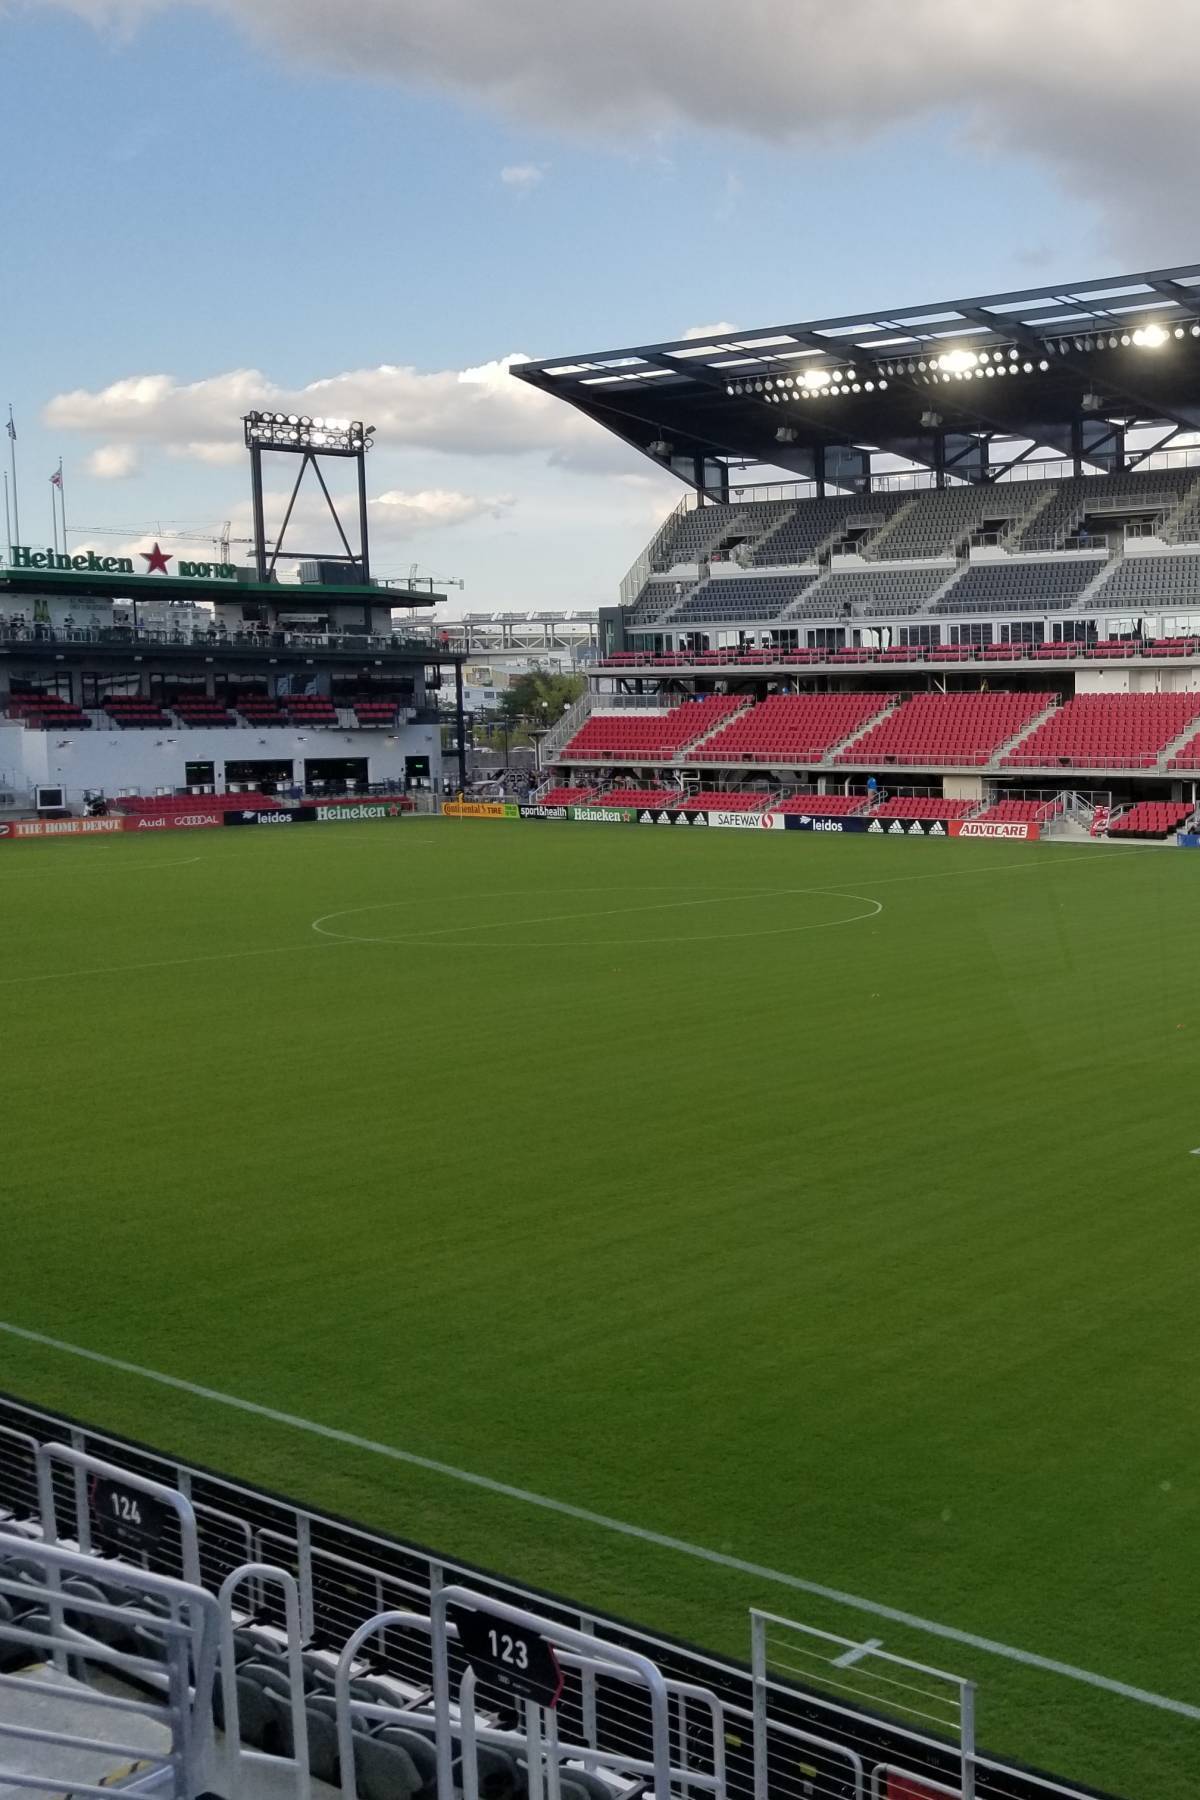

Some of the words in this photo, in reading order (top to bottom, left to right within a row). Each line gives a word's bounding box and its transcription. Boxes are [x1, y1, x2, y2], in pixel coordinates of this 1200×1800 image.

[12, 546, 135, 574] Heineken
[178, 560, 238, 579] ROOFTOP
[257, 812, 293, 824] leidos
[317, 804, 386, 821] Heineken
[487, 806, 502, 815] TIRE
[520, 805, 568, 818] sport&health
[574, 807, 621, 822] Heineken
[16, 823, 44, 836] THE
[45, 821, 81, 834] HOME
[82, 818, 121, 832] DEPOT
[137, 818, 166, 828] Audi
[718, 814, 760, 826] SAFEWAY
[812, 818, 843, 832] leidos
[959, 822, 1028, 838] ADVOCARE
[111, 1492, 141, 1525] 124
[488, 1629, 528, 1670] 123
